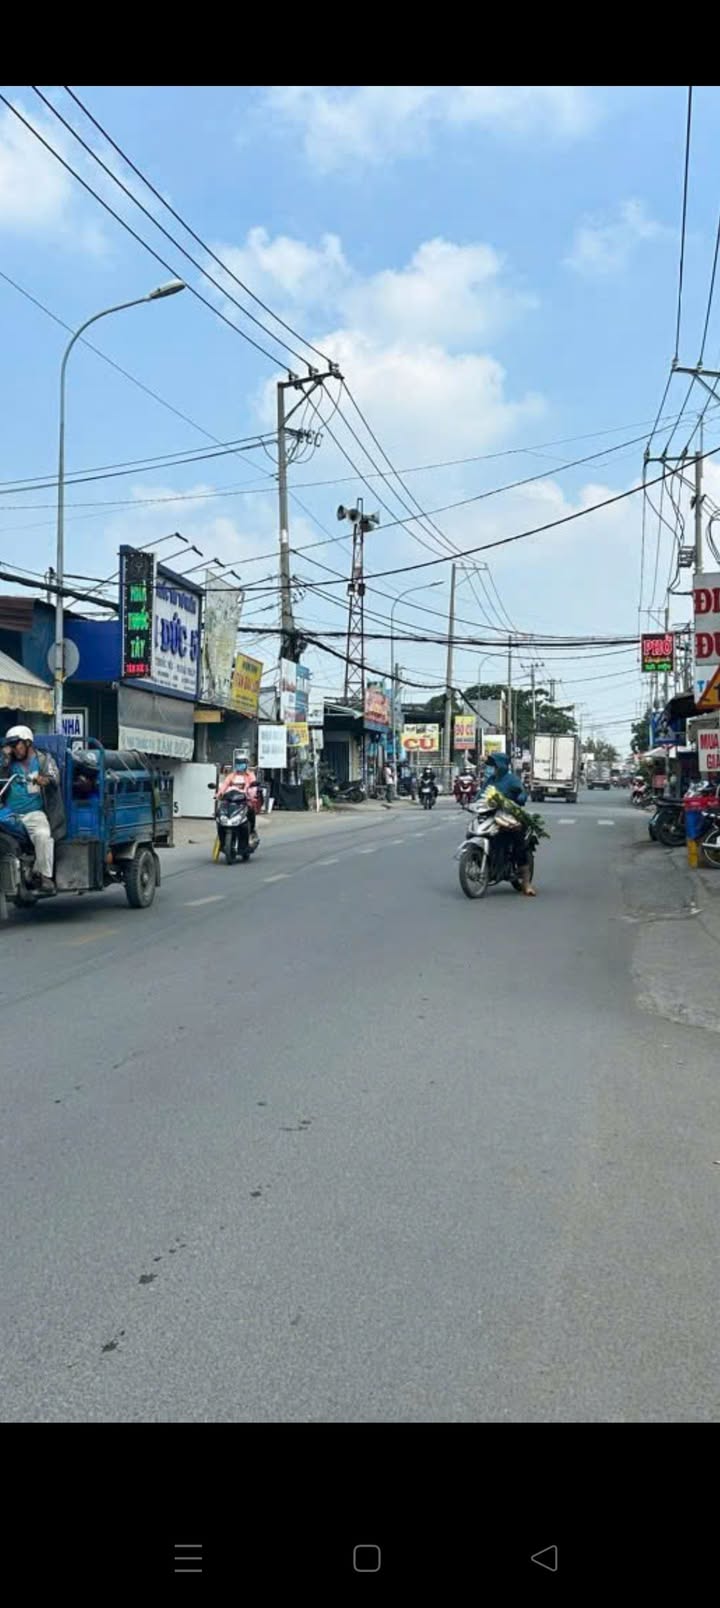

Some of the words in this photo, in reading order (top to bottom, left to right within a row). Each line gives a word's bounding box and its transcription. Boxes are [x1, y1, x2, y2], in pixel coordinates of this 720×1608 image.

[130, 636, 146, 658] TÂY
[189, 630, 199, 662] 5
[643, 633, 672, 655] PHỞ
[403, 734, 434, 750] CŨ
[700, 732, 719, 750] MUA
